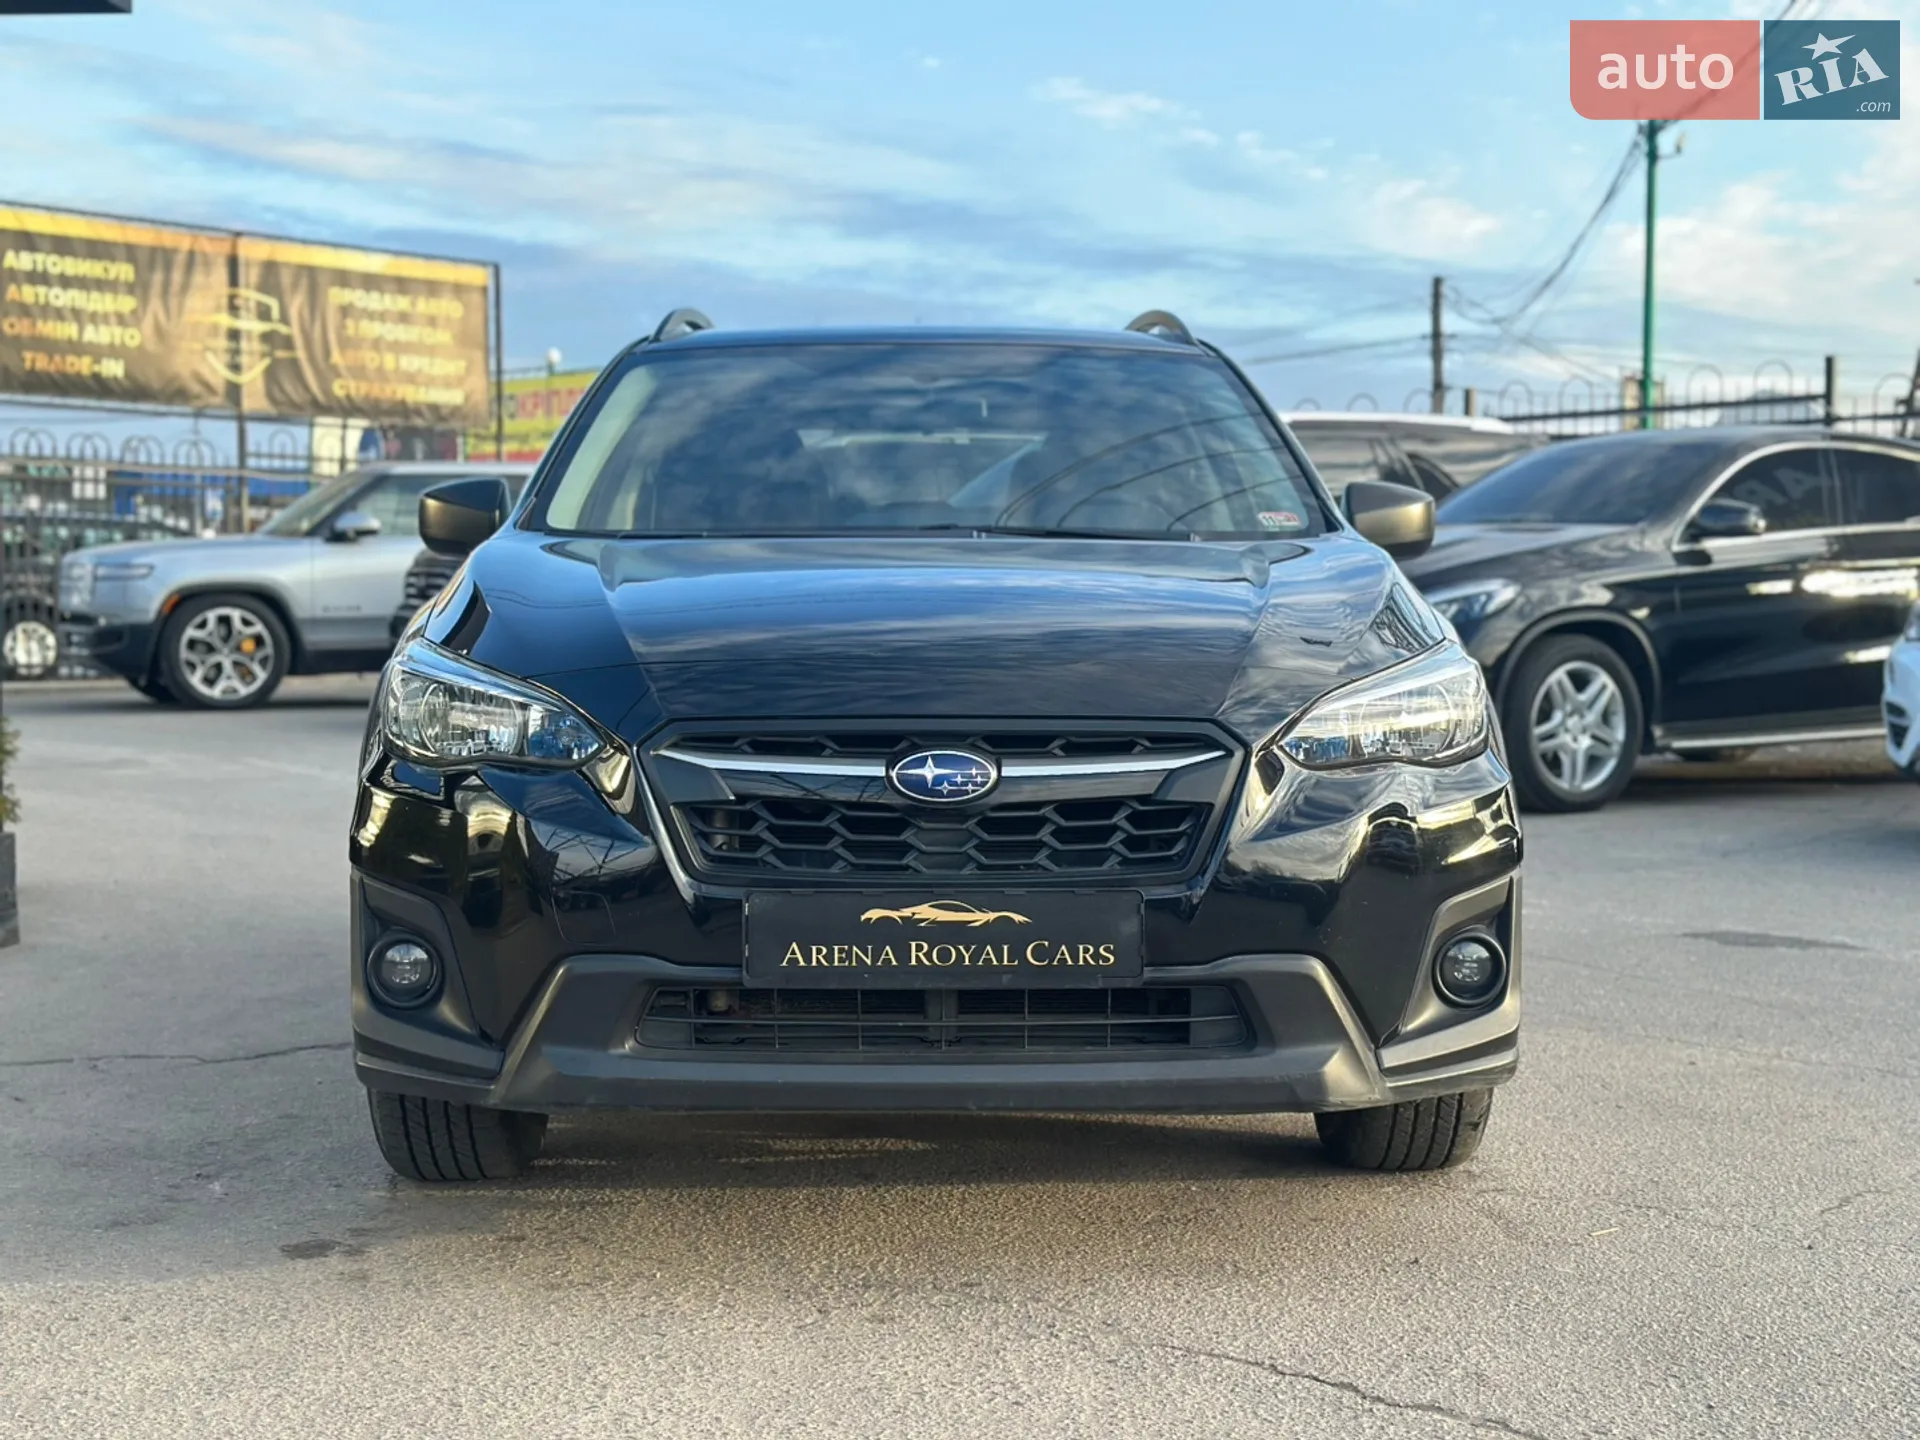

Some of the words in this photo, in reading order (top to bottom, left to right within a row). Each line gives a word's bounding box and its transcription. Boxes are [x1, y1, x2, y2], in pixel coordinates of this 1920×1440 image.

[3, 249, 136, 283] АВТОВИКУП
[82, 323, 142, 348] АВТО
[22, 350, 126, 378] TRADE-IN
[780, 941, 898, 966] ARENA
[908, 941, 1018, 966] ROYAL
[1025, 940, 1116, 966] CARS
